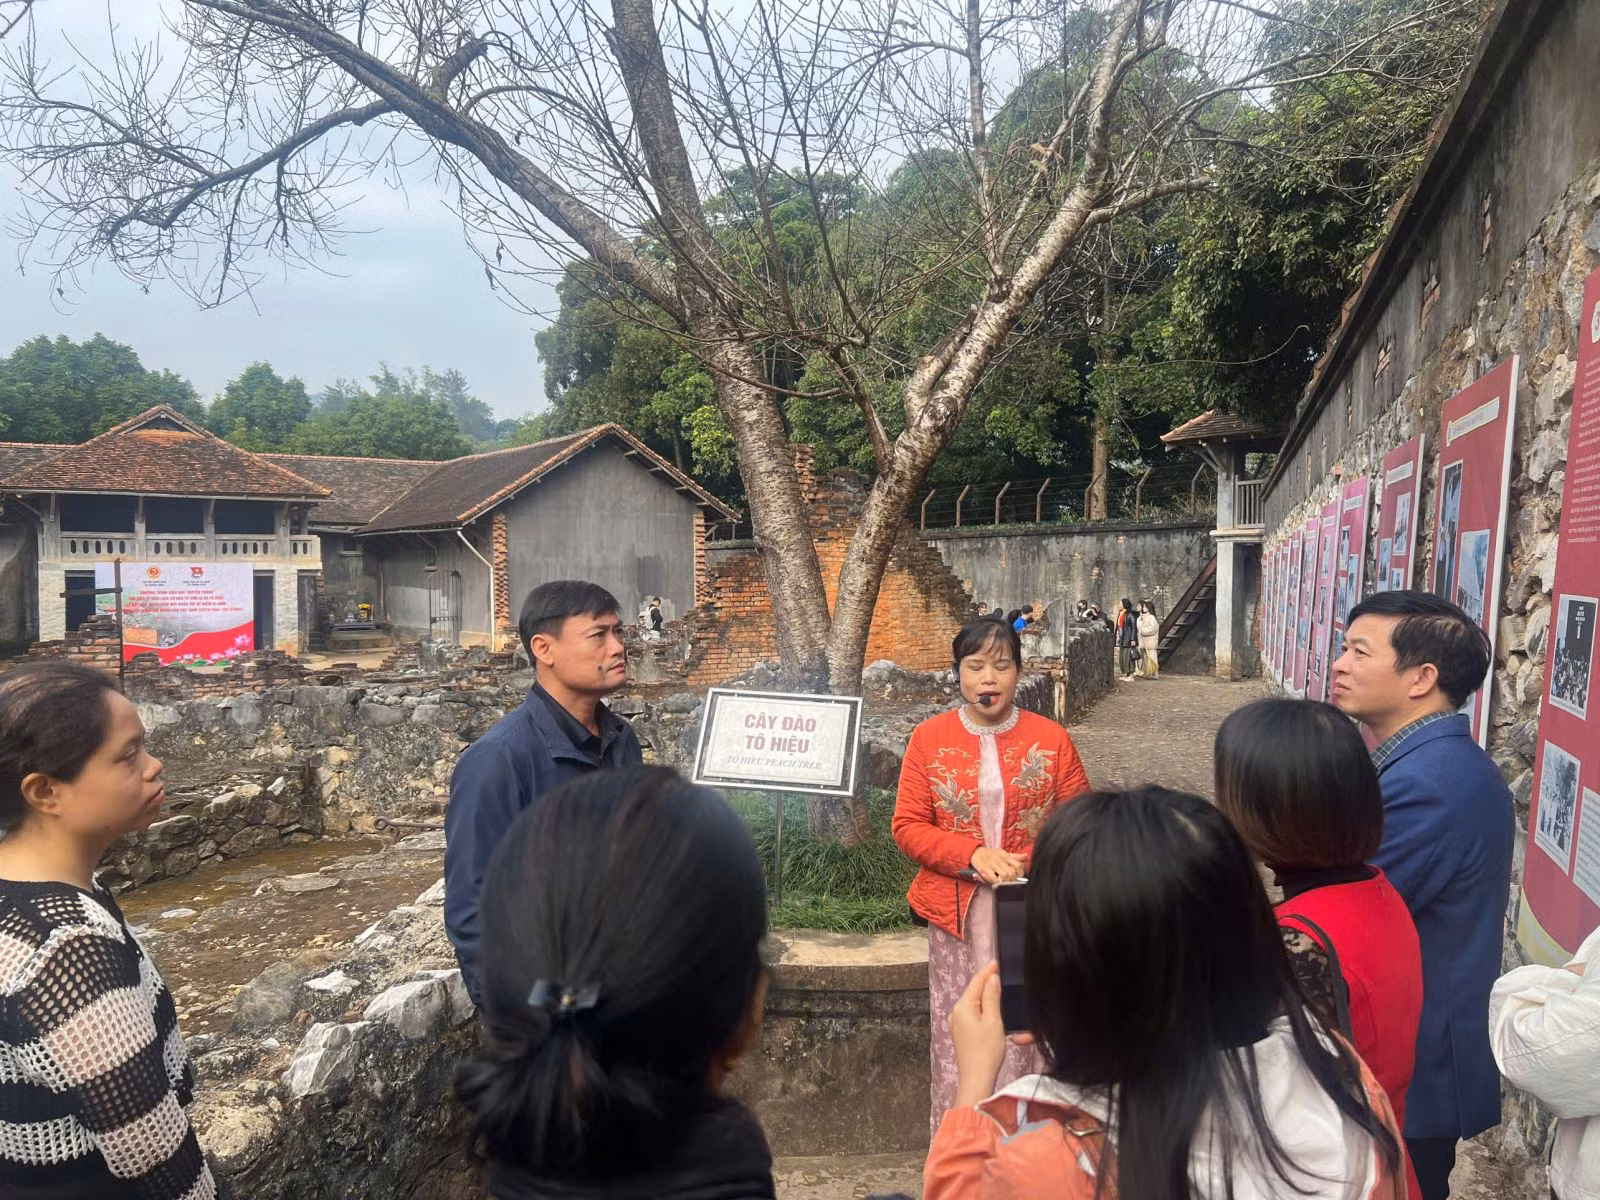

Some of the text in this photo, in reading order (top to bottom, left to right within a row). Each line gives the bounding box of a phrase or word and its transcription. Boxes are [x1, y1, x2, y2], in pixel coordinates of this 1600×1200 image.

[744, 712, 816, 732] CÂY ĐÀO
[745, 733, 810, 756] TÔ HIỆU
